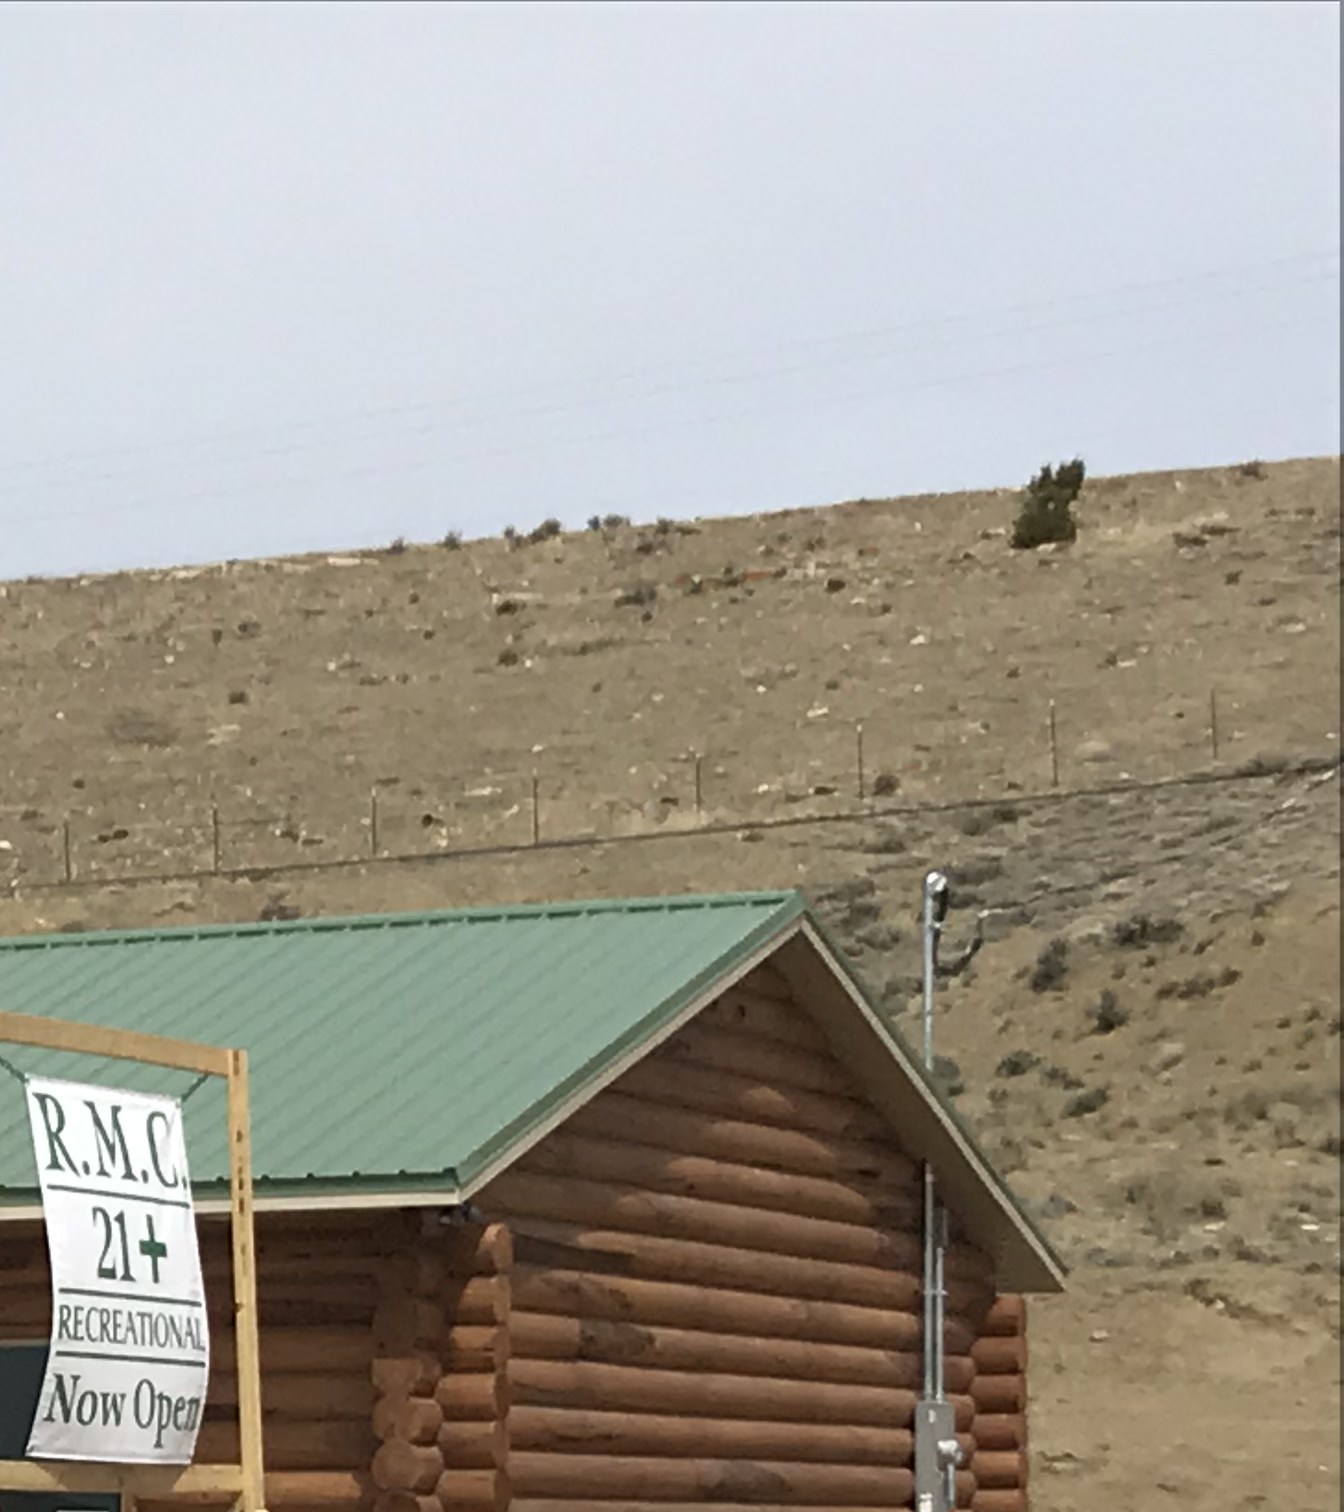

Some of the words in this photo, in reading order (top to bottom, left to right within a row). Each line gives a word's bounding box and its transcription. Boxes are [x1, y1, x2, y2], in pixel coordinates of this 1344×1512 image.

[32, 1092, 188, 1190] R.M.C.
[92, 1206, 168, 1284] 21+
[58, 1304, 206, 1352] RECREATIONAL
[43, 1372, 127, 1427] Now
[134, 1378, 200, 1449] Open
